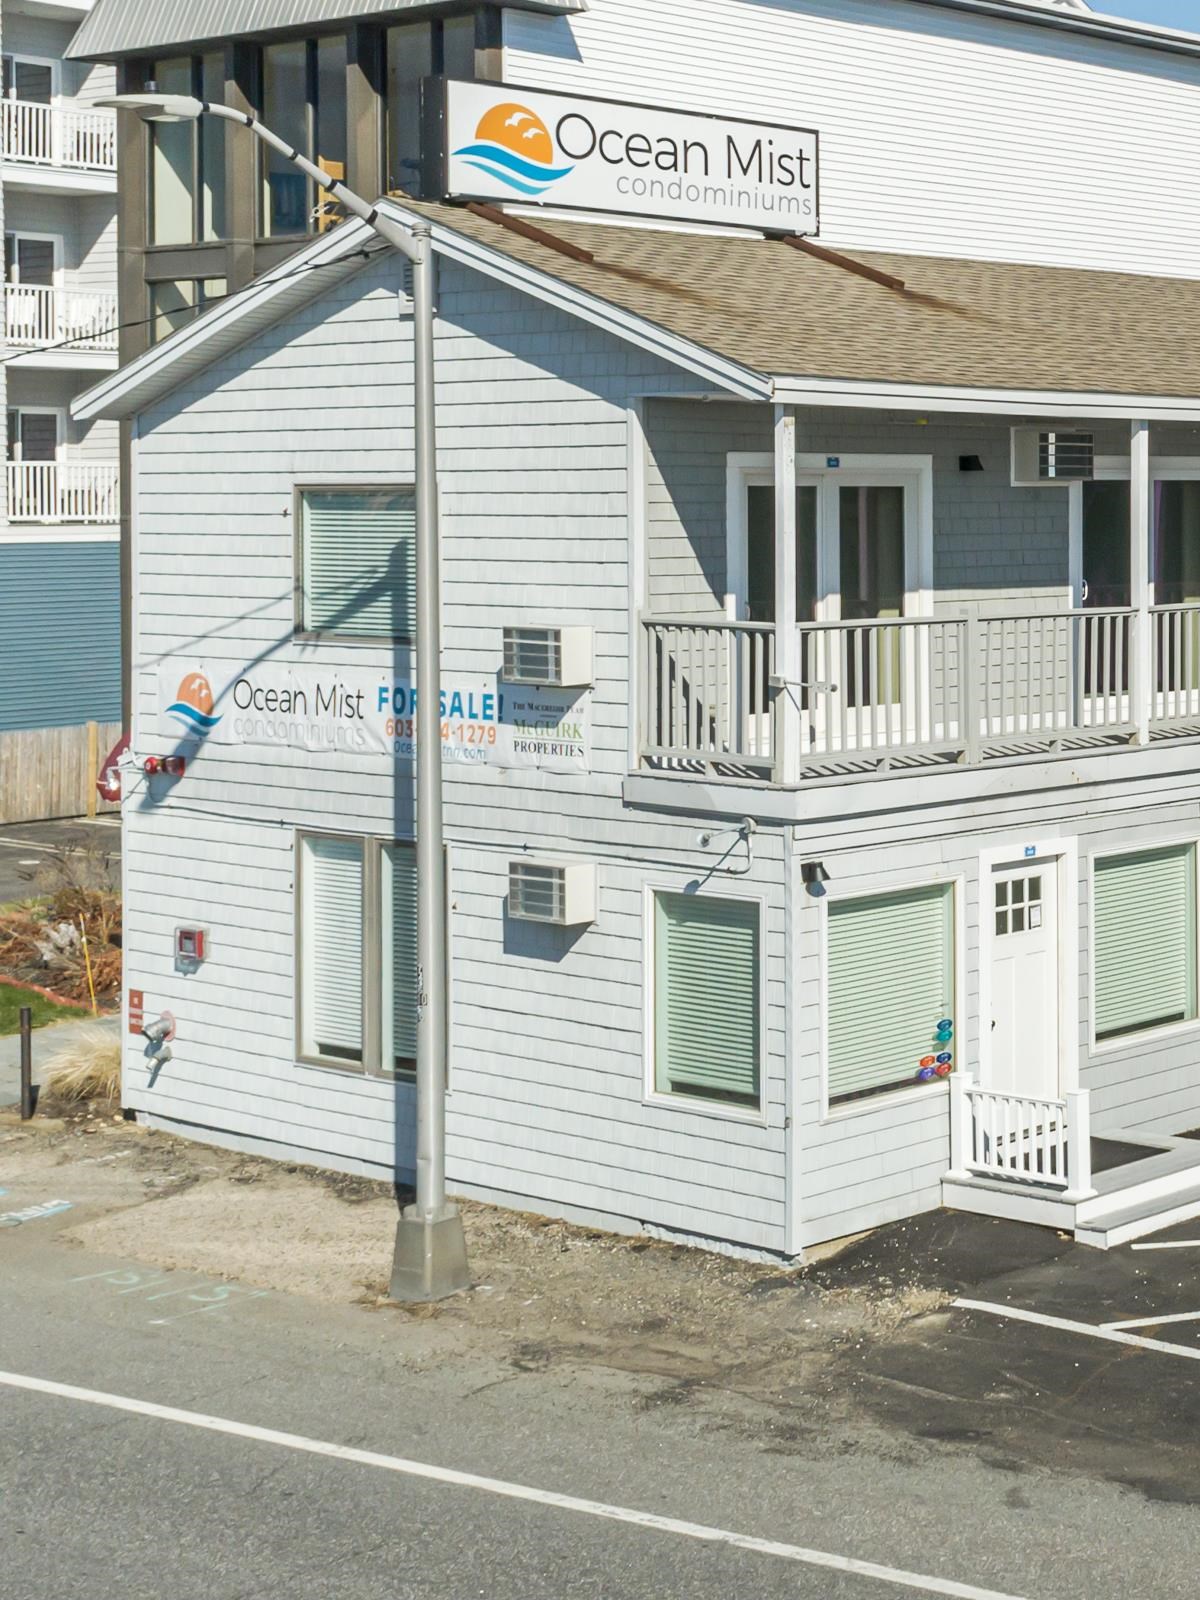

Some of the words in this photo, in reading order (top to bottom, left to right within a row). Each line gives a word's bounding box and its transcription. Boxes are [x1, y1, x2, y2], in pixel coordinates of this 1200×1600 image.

[556, 113, 708, 176] Ocean
[726, 134, 811, 189] Mist
[616, 175, 813, 216] condominiums
[233, 678, 307, 715] Ocean
[315, 682, 365, 719] Mist
[232, 717, 366, 745] condominiums
[513, 740, 584, 757] PROPERTIES
